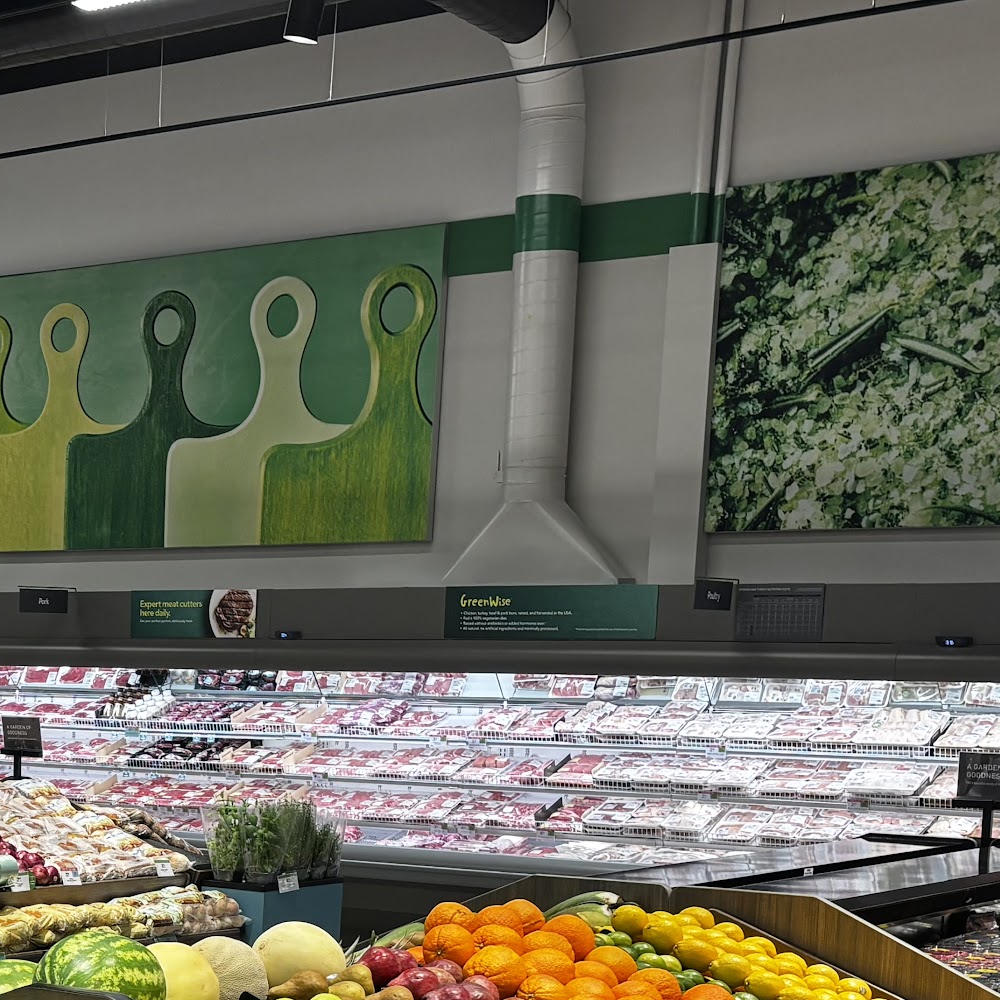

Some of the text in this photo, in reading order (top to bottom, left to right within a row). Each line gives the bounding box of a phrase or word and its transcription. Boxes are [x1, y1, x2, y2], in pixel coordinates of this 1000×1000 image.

[38, 597, 49, 605] Pork
[139, 600, 203, 610] Expert meat cutters
[460, 593, 512, 608] GreenWise
[155, 608, 171, 619] daily.
